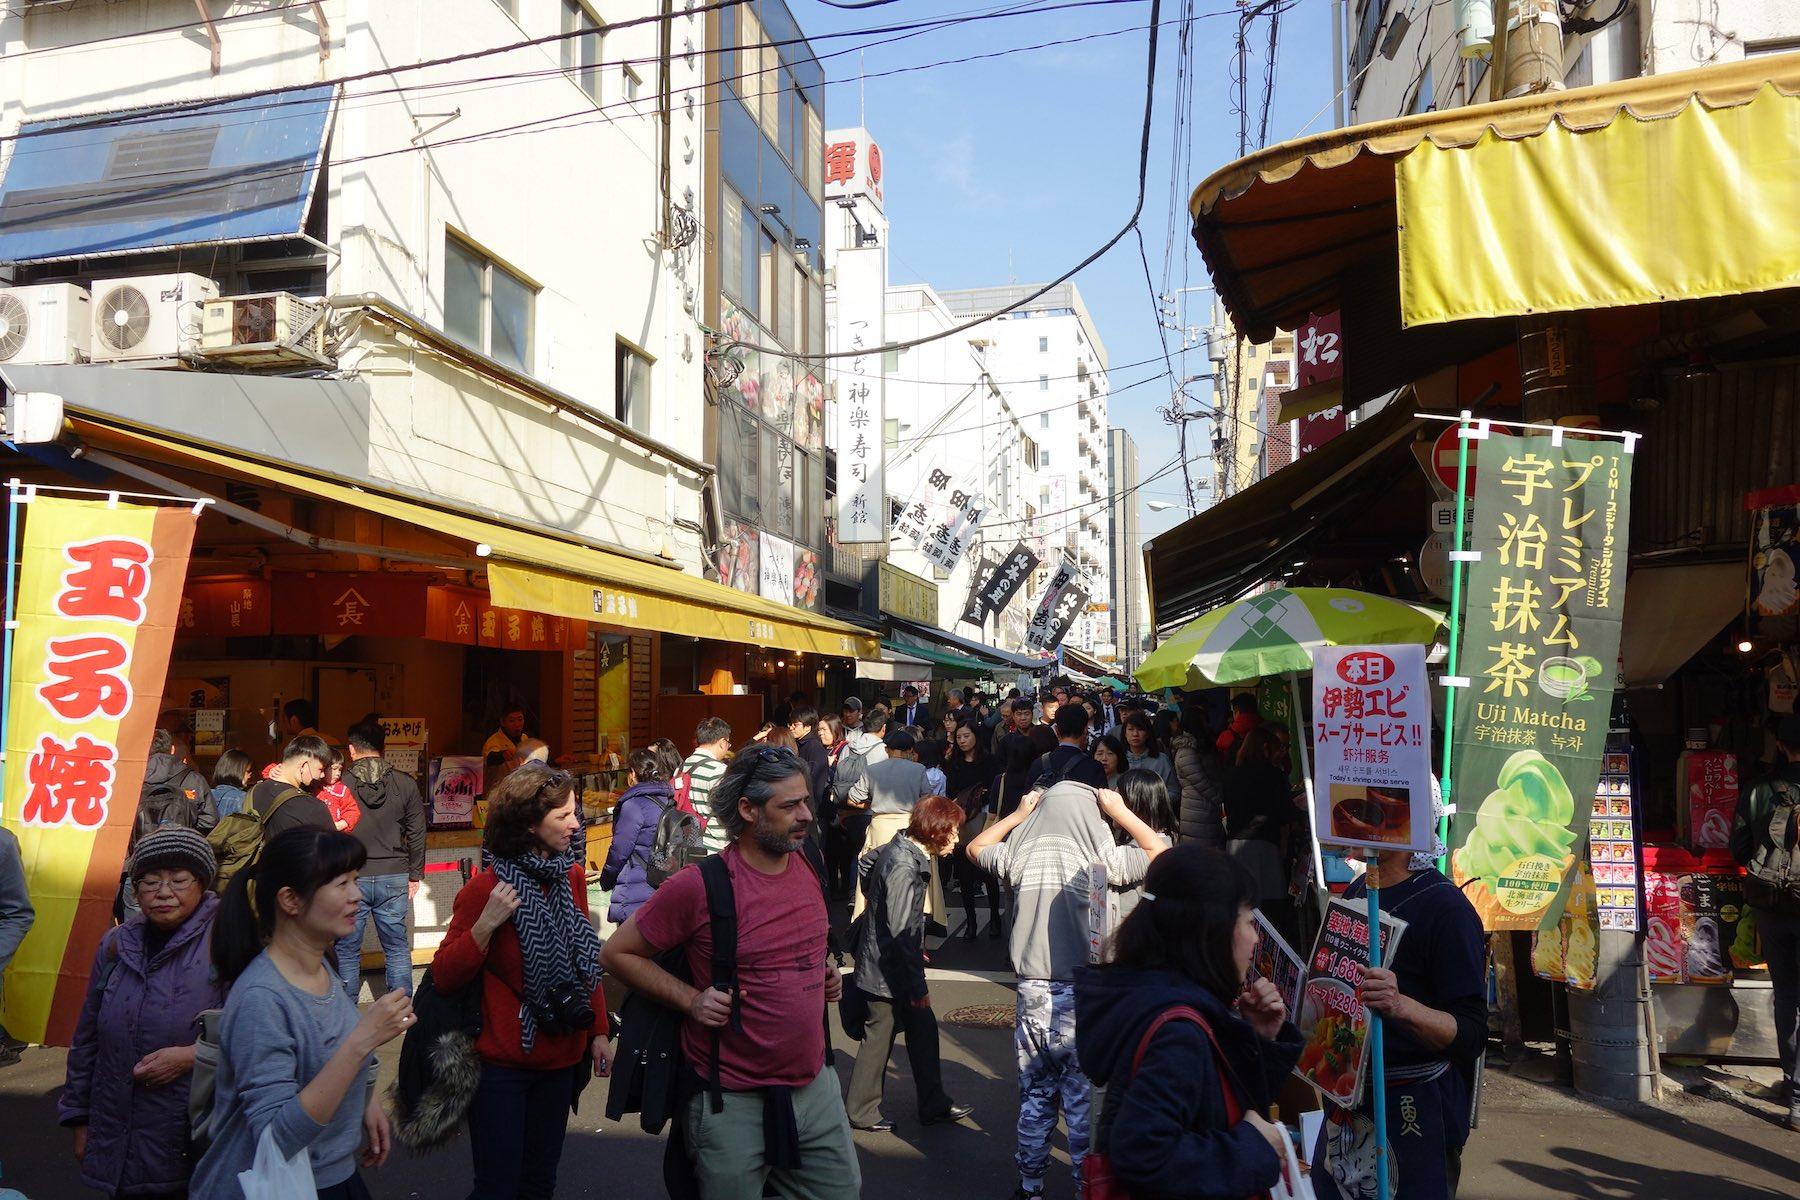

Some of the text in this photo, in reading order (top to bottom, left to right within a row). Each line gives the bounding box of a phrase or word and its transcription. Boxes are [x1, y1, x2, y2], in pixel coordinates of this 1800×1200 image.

[1542, 455, 1605, 650] プレミアム
[1484, 453, 1555, 698] 宇治抹茶
[1586, 557, 1600, 608] Premium
[24, 540, 149, 826] 玉子焼
[1345, 657, 1385, 682] 本日
[1323, 685, 1410, 718] 伊勢エビ
[1477, 702, 1587, 732] Uji Matcha
[1474, 724, 1537, 746] 宇治抹茶
[1550, 732, 1584, 752] 녹차
[435, 780, 473, 796] Asahi
[1330, 774, 1350, 783] Today's
[1352, 776, 1371, 785] shrimp
[1373, 778, 1388, 786] soup
